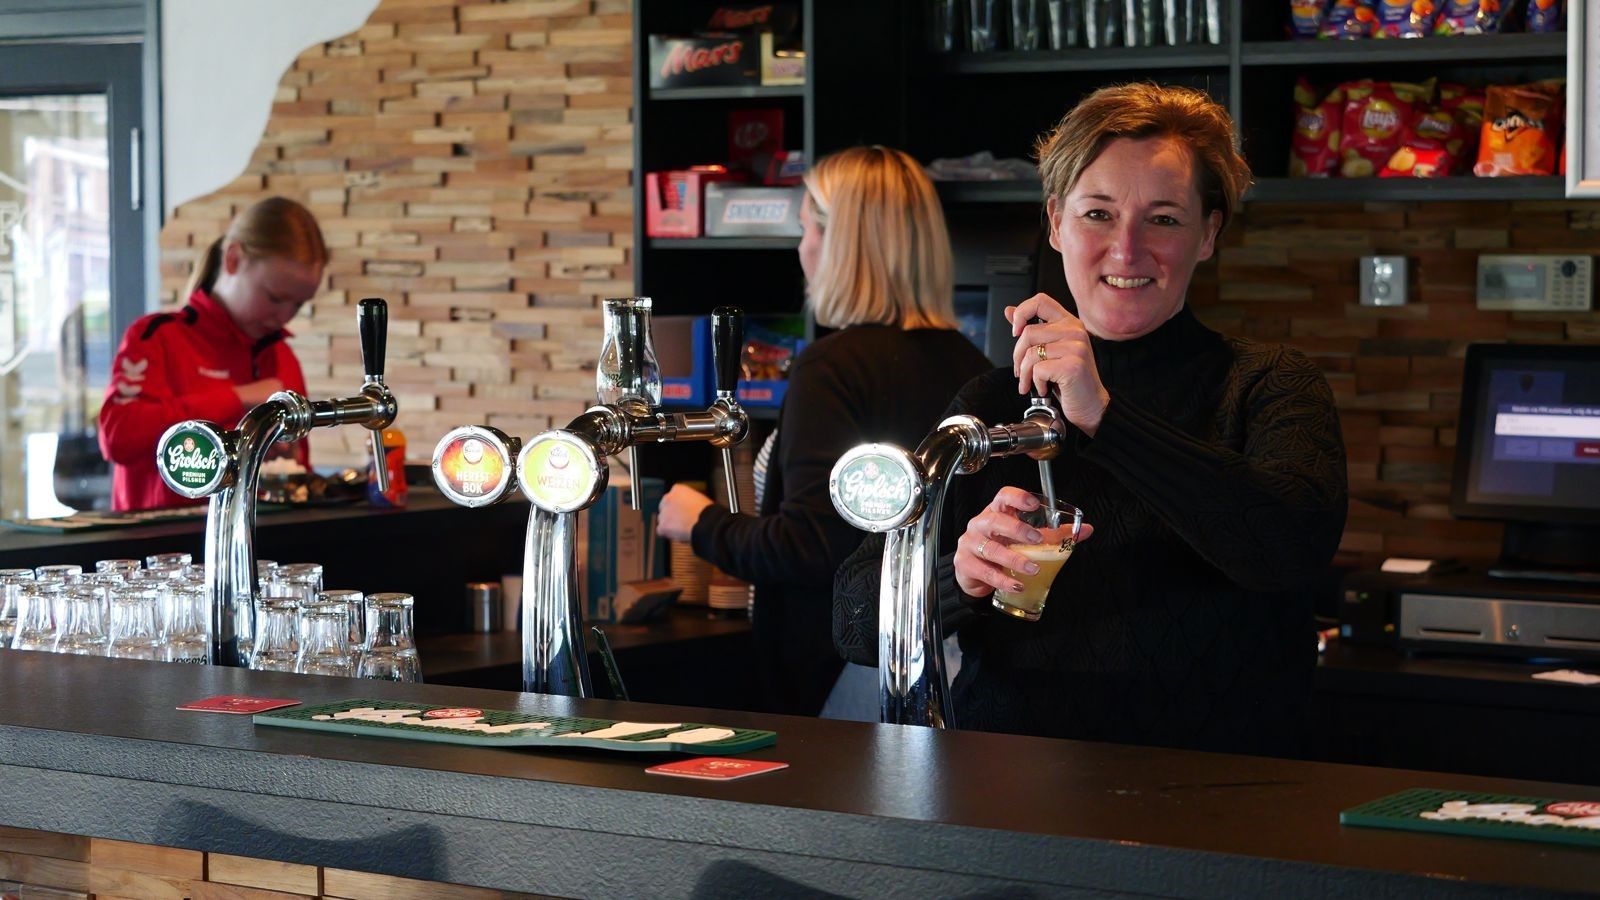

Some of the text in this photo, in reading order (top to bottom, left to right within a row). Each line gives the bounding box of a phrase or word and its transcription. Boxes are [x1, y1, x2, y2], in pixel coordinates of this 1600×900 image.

[661, 40, 743, 79] Mars
[168, 444, 217, 472] Grolsch
[456, 471, 489, 482] HERFST
[536, 474, 581, 489] WEIZEN
[843, 469, 908, 502] Grolsch
[462, 482, 484, 494] BOK
